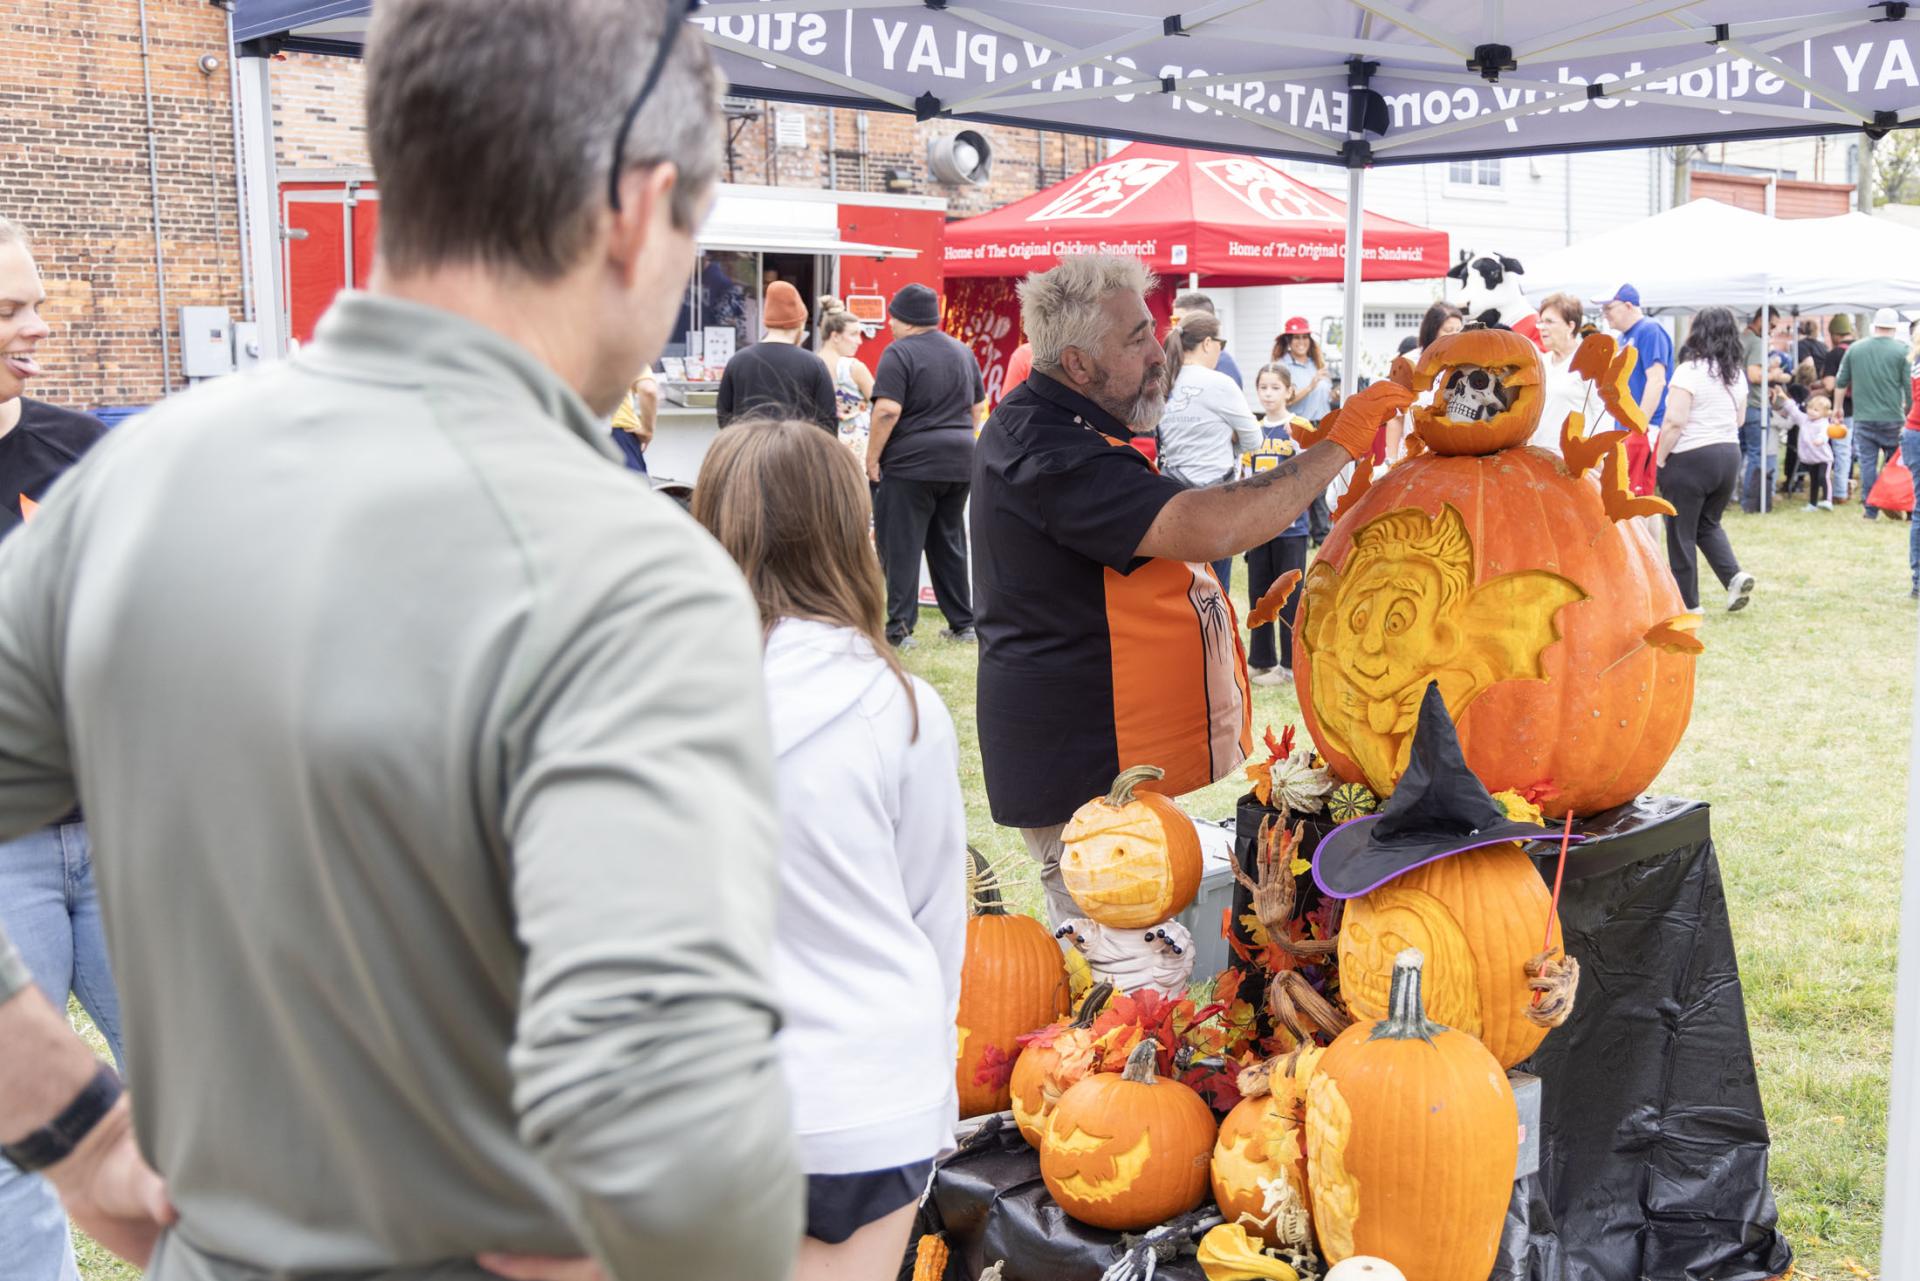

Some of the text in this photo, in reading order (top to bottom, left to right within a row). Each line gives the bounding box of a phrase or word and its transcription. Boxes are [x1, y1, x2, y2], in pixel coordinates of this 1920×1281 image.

[943, 246, 974, 260] Home
[974, 245, 986, 259] of
[987, 243, 1008, 258] The
[1009, 242, 1051, 260] Original
[1228, 241, 1261, 257] Home
[1262, 242, 1276, 257] of
[1276, 242, 1296, 258] The
[1298, 243, 1338, 261] Original
[1378, 245, 1424, 261] Sandwich
